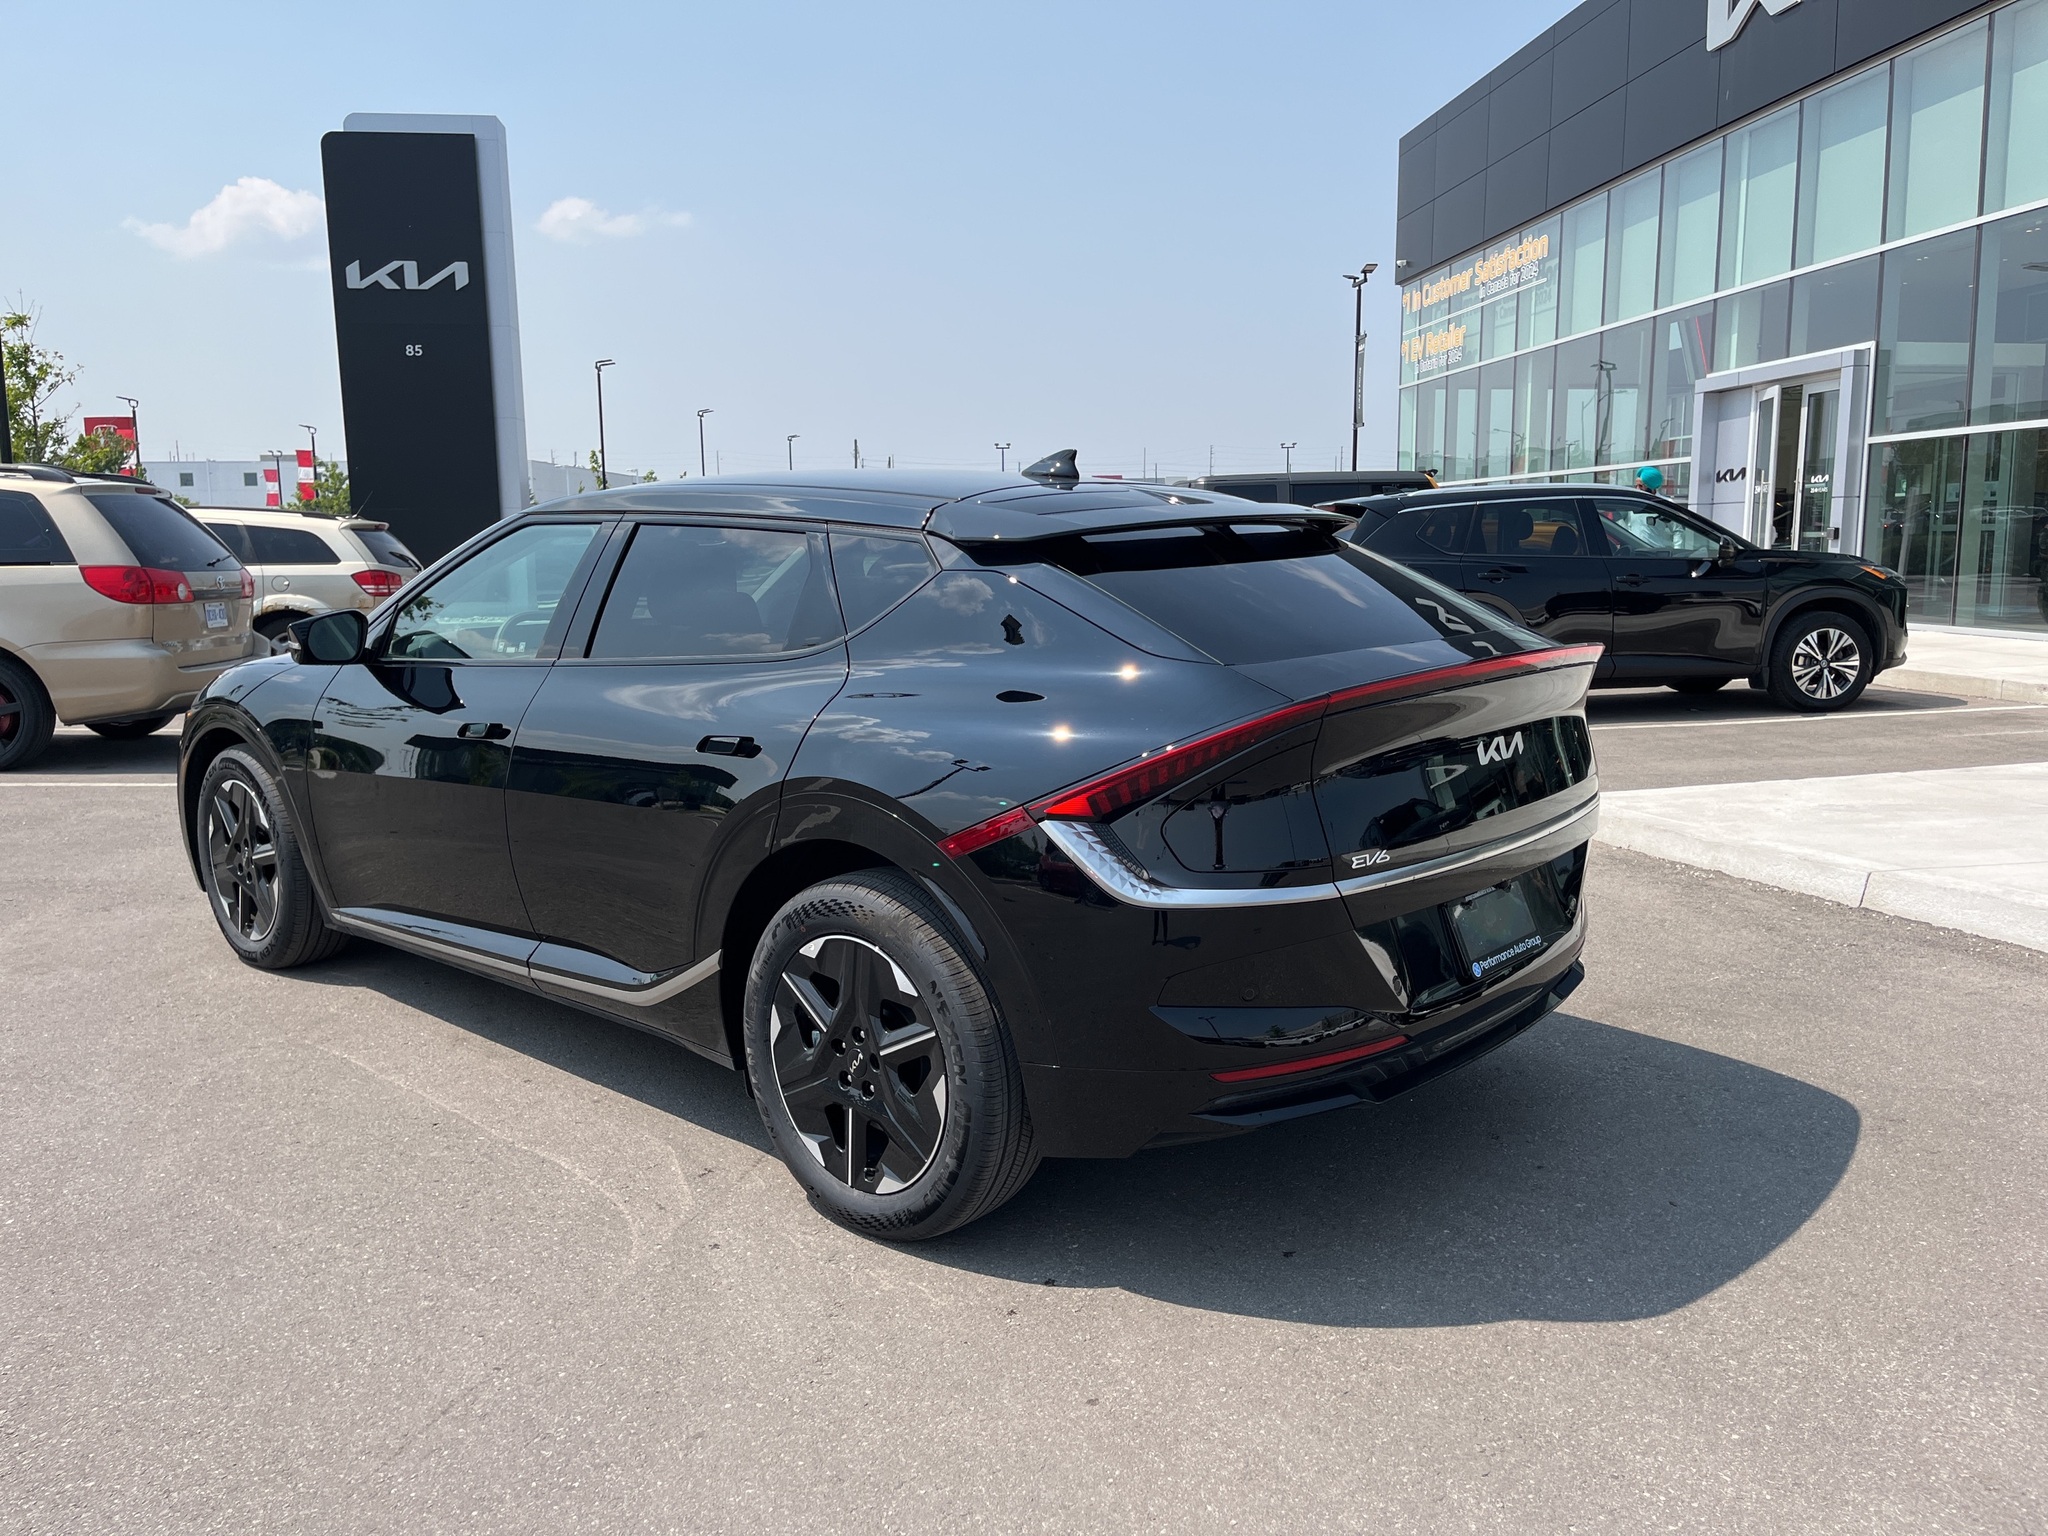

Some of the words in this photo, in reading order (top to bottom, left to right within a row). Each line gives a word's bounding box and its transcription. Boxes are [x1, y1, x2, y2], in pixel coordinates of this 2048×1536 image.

[345, 259, 469, 291] KIA
[1422, 267, 1474, 307] Customer
[1474, 234, 1549, 286] Satisfaction
[1486, 275, 1509, 295] Canada
[1509, 270, 1520, 286] for
[405, 344, 423, 356] 85
[1411, 334, 1425, 362] EV
[1426, 322, 1466, 357] Retailer
[1716, 467, 1746, 483] KIA
[1811, 474, 1829, 484] KIA
[1477, 731, 1524, 766] KIA
[1351, 849, 1390, 869] EV6
[1479, 947, 1515, 971] Performance
[1513, 942, 1527, 955] Auto
[1525, 935, 1542, 948] Group
[928, 979, 968, 1086] NEXEN
